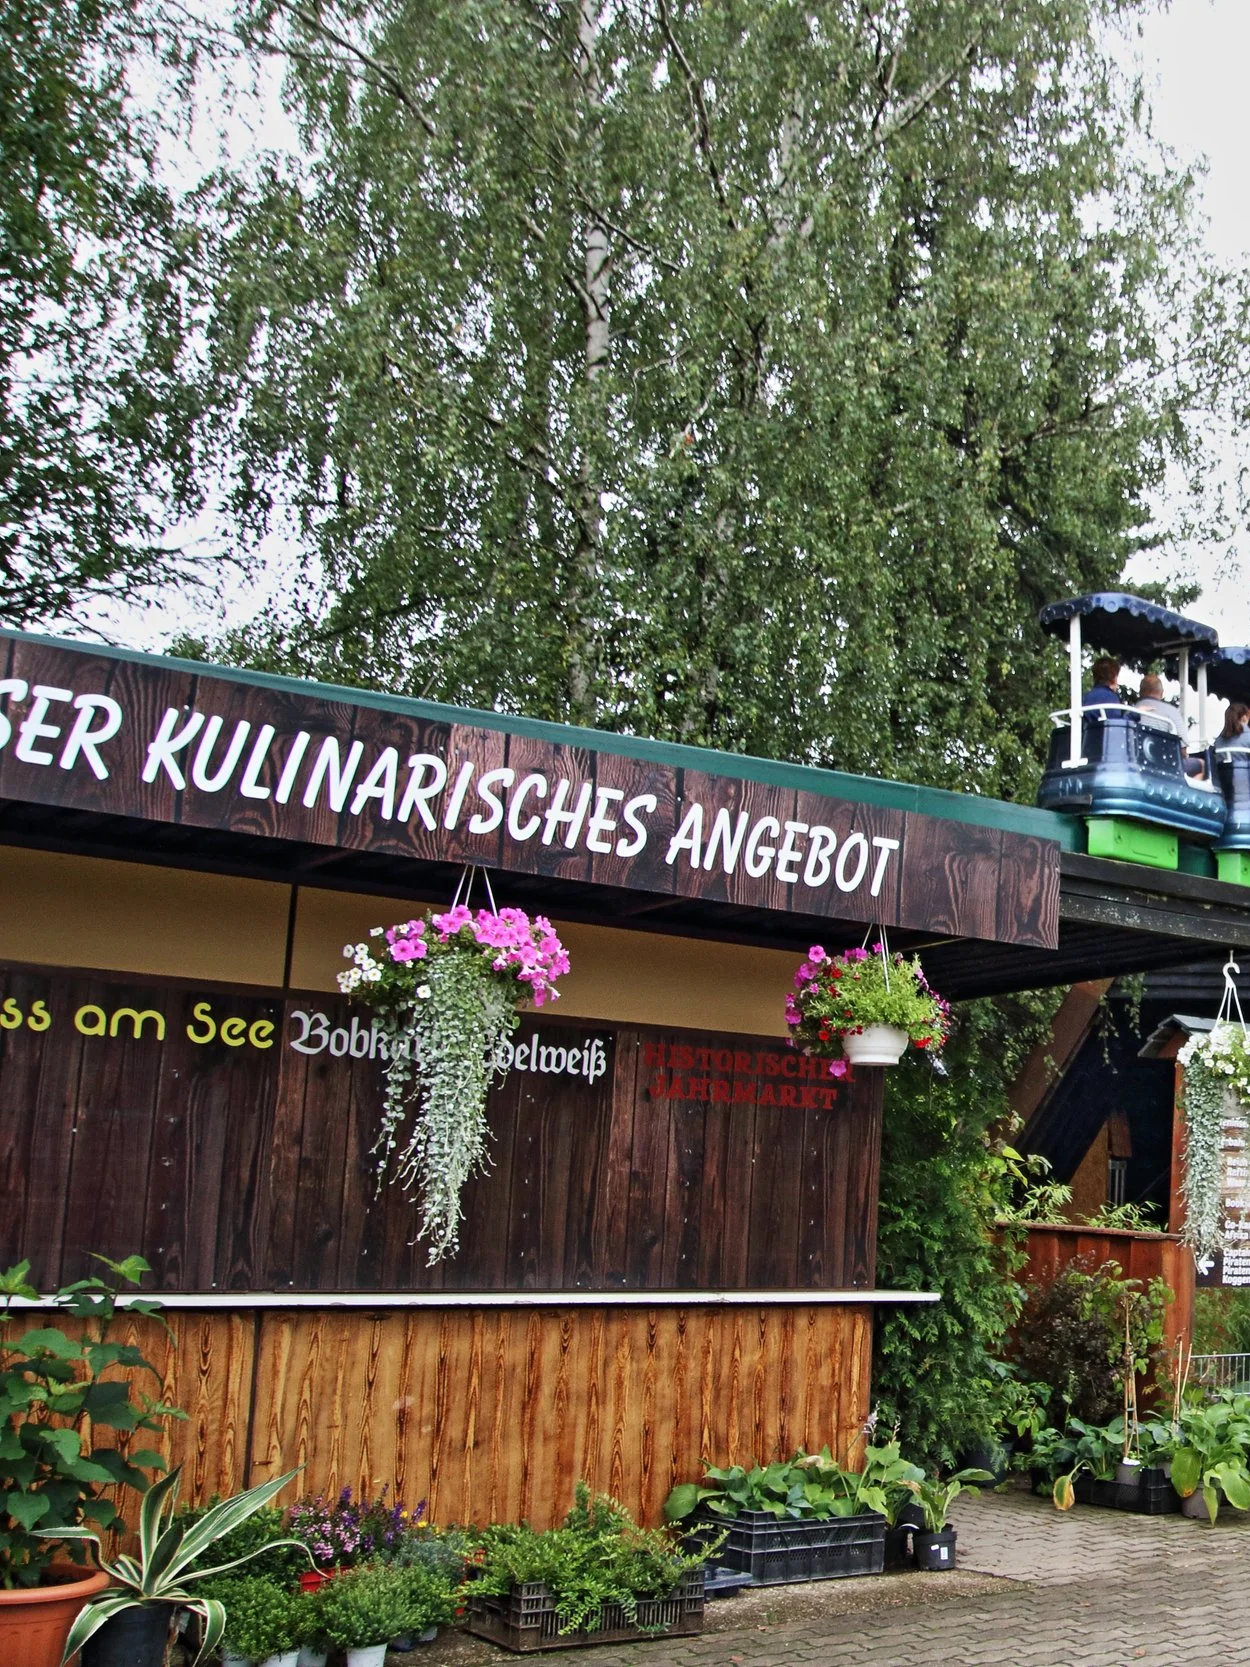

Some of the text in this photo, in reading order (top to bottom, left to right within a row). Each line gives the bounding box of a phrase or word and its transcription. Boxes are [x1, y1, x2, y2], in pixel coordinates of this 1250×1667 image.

[142, 707, 658, 859] KULINARISCHES
[665, 802, 899, 897] ANGEBOT
[74, 1004, 166, 1041] am
[187, 1002, 275, 1049] See
[650, 1074, 838, 1110] JAHRMARKT
